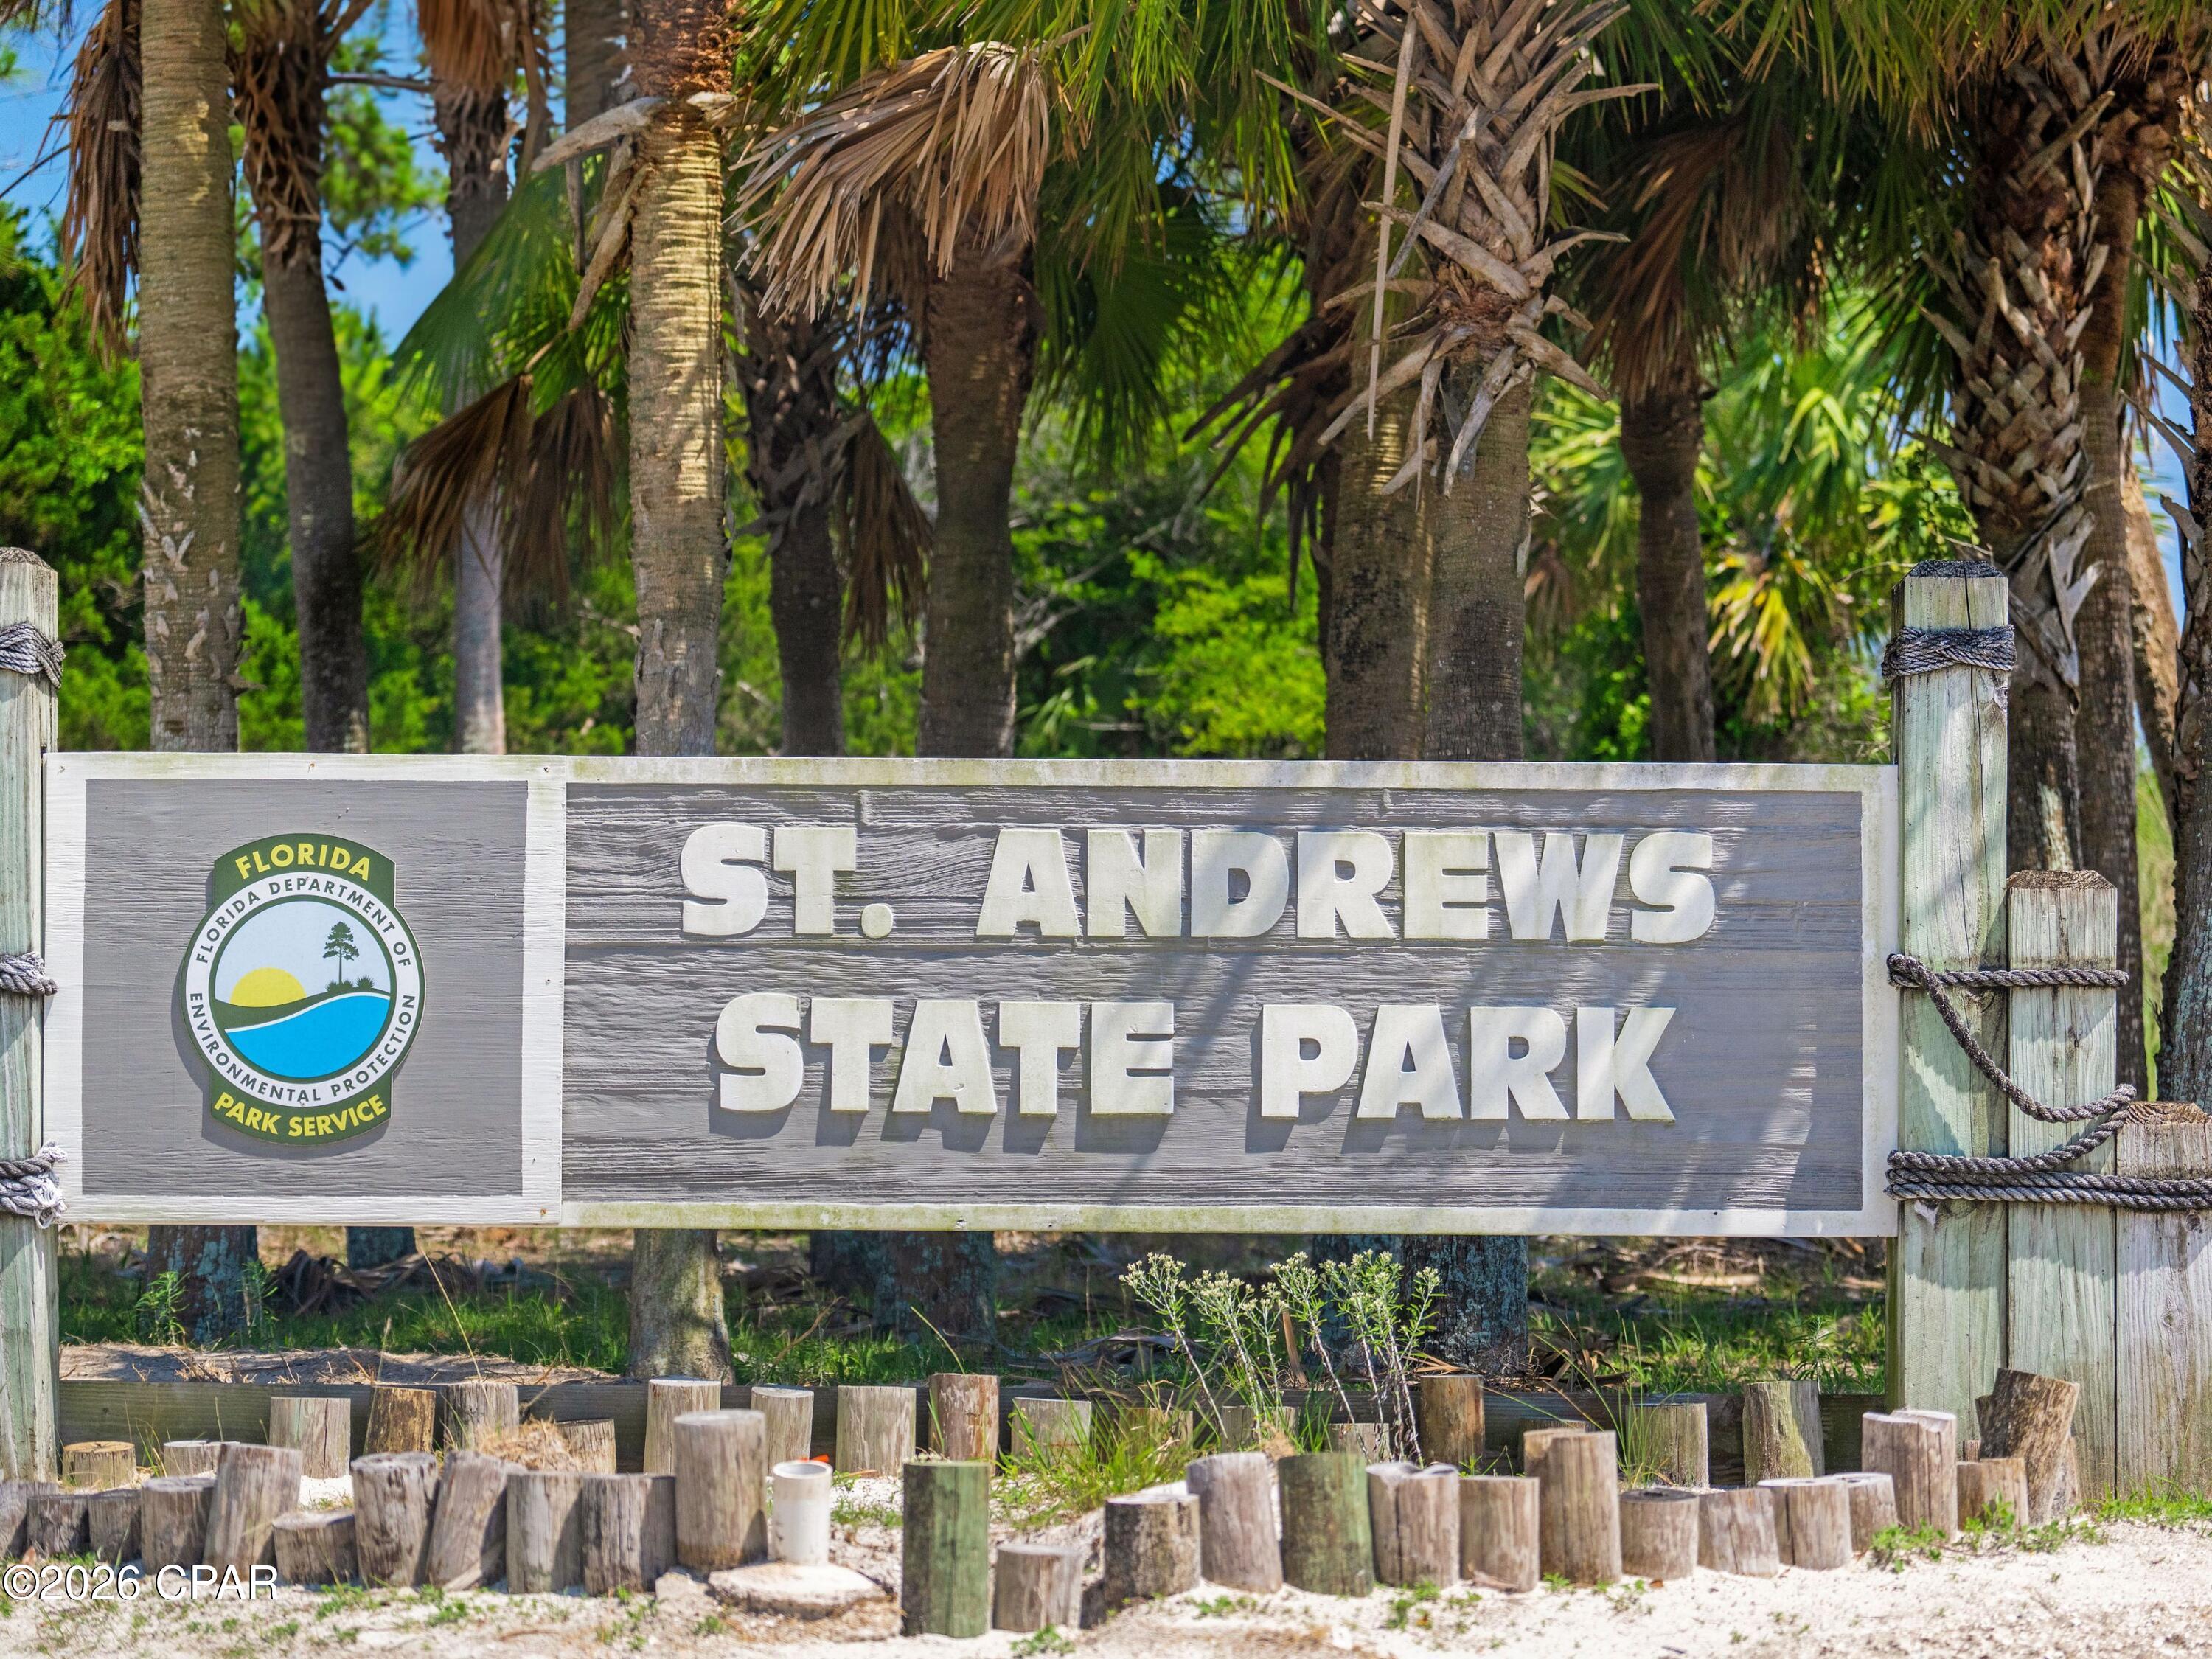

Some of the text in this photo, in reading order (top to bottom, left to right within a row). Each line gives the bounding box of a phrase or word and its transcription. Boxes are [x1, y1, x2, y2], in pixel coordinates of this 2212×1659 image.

[235, 843, 370, 881] FLORIDA
[680, 823, 1716, 943] ST. ANDREWS
[196, 878, 411, 967] FLORIDA DEPARTMENT OF
[190, 992, 415, 1102] ENVIRONMENTAL PROTECTION
[716, 993, 1676, 1121] STATE PARK
[214, 1091, 386, 1136] PARK SERVICE
